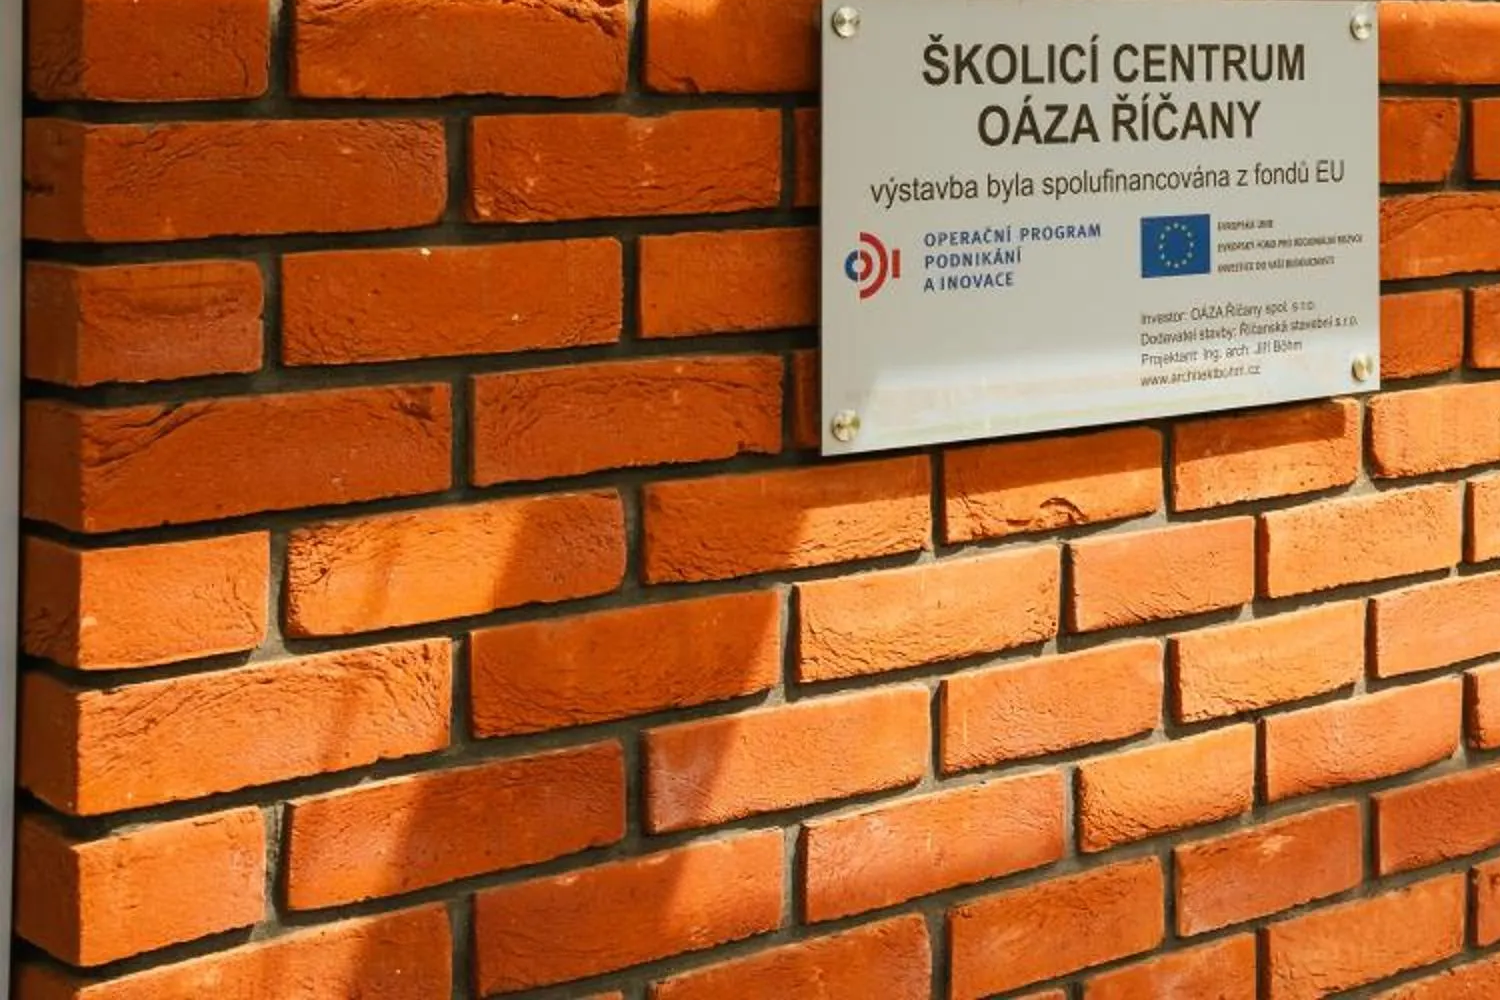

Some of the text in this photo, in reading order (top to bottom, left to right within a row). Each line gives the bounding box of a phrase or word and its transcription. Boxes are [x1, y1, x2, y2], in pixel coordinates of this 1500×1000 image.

[922, 34, 1305, 85] ŠKOLICÍ CENTRUM
[977, 92, 1261, 146] OÁZA ŘÍČANY
[871, 159, 1345, 209] výstavba byla spolufinancována z fondů EU
[923, 223, 1101, 247] OPERAČNÍ PROGRAM
[924, 246, 1021, 270] PODNIKÁNÍ
[923, 271, 1014, 292] A INOVACE
[1191, 306, 1223, 321] OÁZA
